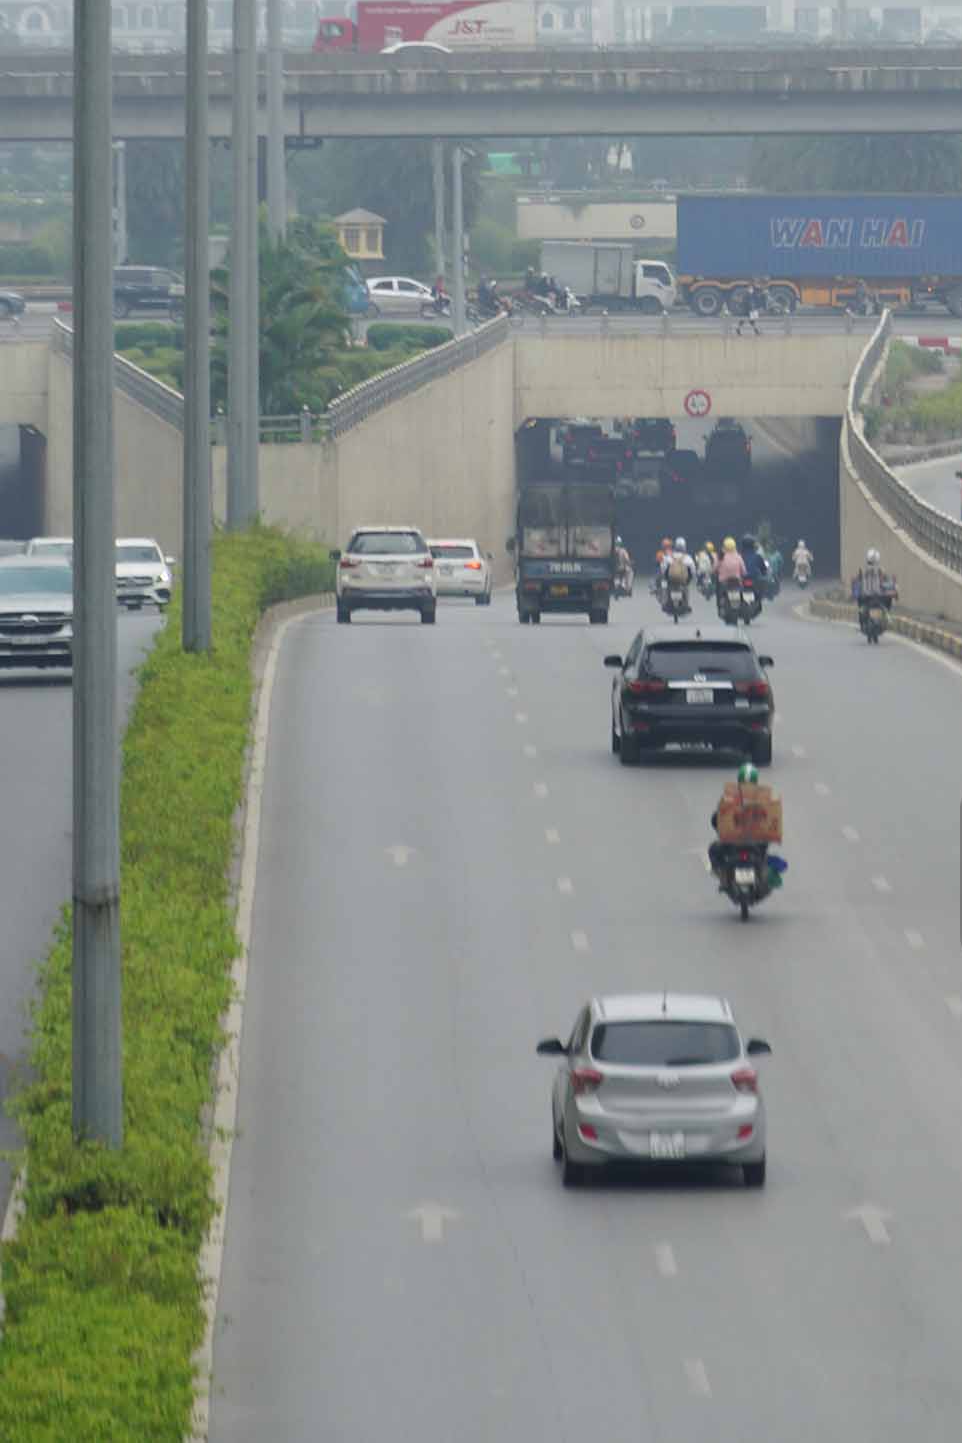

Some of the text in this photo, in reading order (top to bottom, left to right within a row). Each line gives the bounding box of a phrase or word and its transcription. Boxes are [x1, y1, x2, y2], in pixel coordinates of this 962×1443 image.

[448, 19, 488, 35] J&T
[769, 215, 926, 248] WAN HAI
